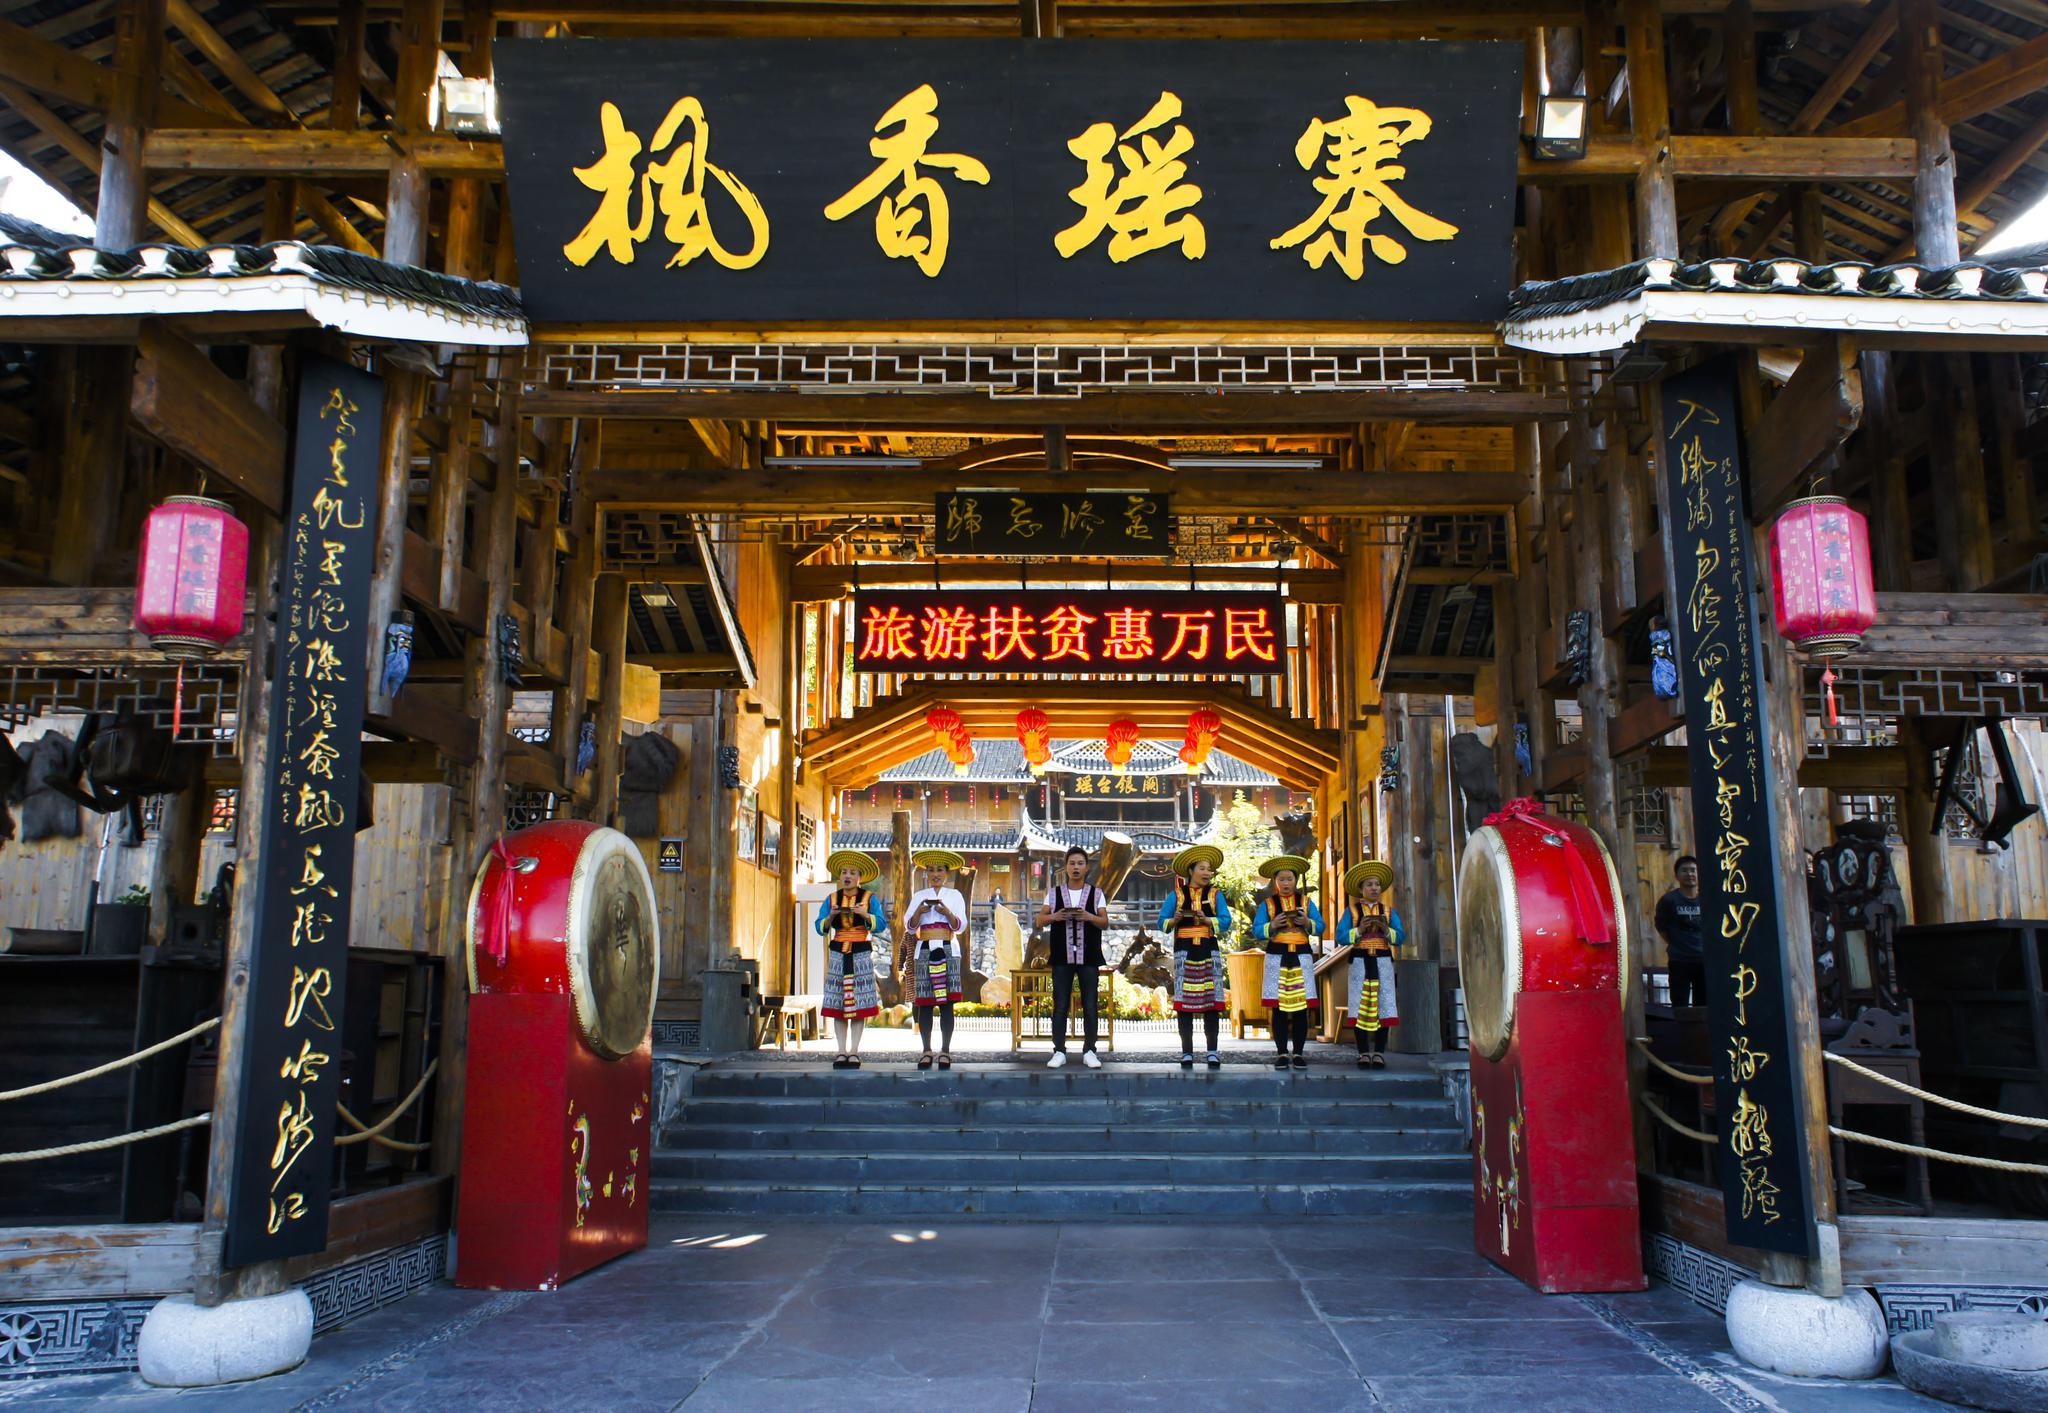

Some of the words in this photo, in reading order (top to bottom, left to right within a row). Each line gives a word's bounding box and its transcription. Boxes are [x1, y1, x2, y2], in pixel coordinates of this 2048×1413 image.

[859, 605, 1276, 661] 旅游扶贫惠万民
